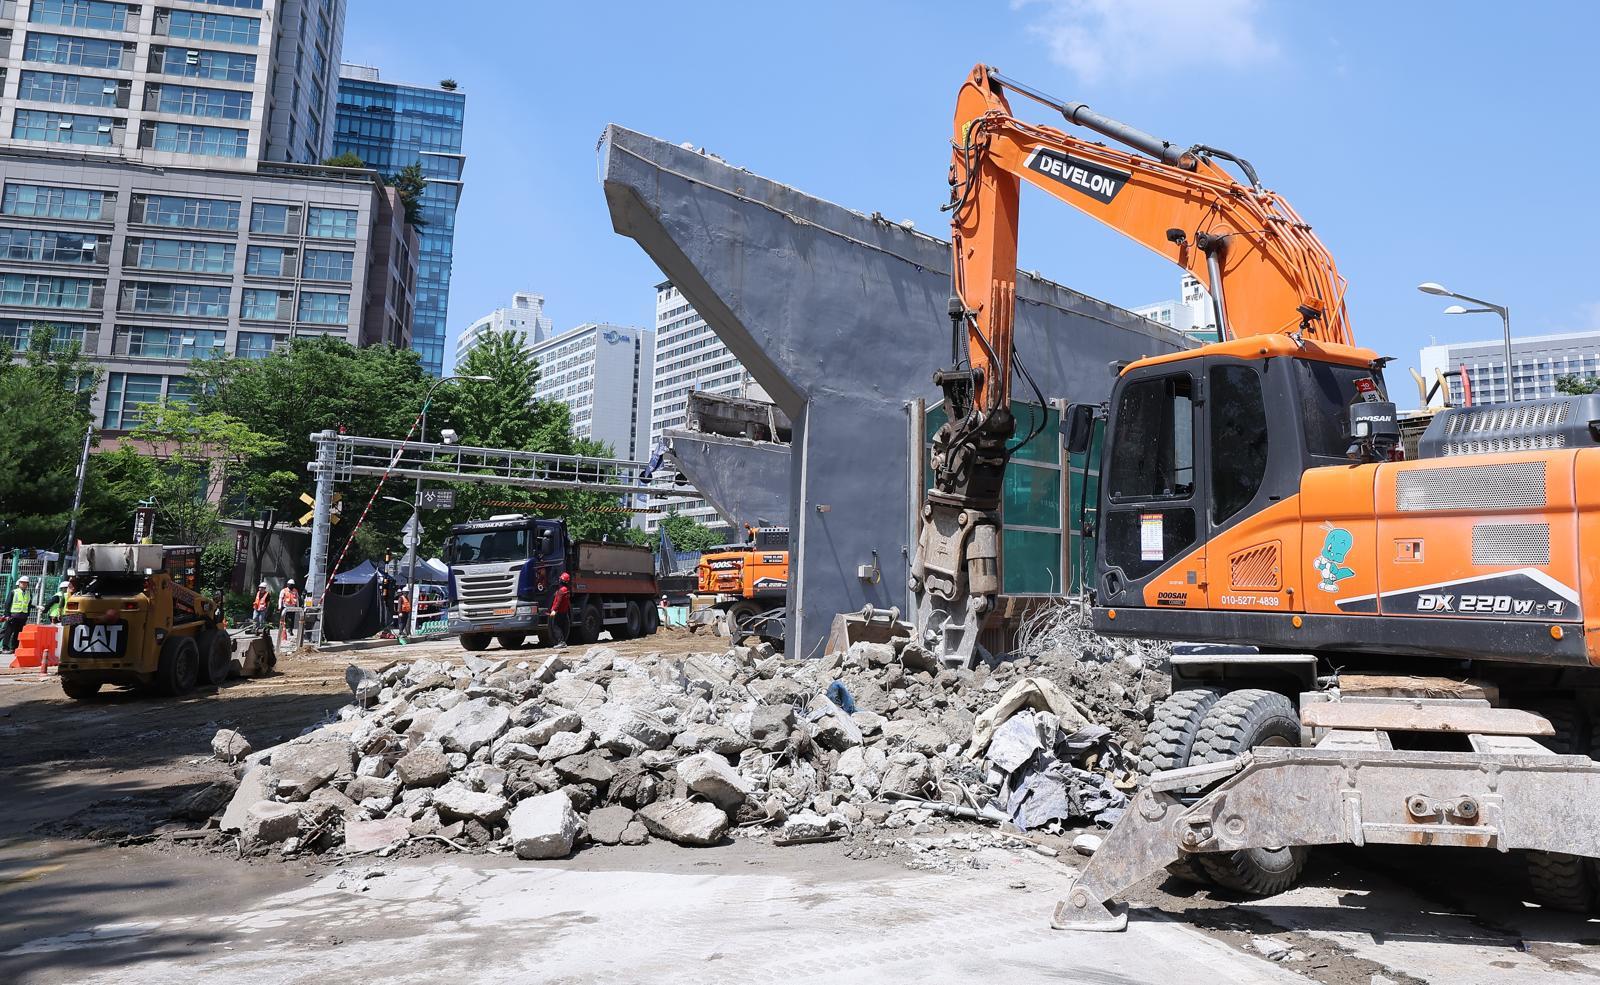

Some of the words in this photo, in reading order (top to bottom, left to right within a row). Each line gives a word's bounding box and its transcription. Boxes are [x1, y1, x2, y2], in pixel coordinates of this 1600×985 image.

[1039, 155, 1116, 197] DEVELON
[1221, 595, 1280, 606] 010-5277-4839
[1417, 594, 1455, 612] DX
[73, 624, 123, 653] CAT
